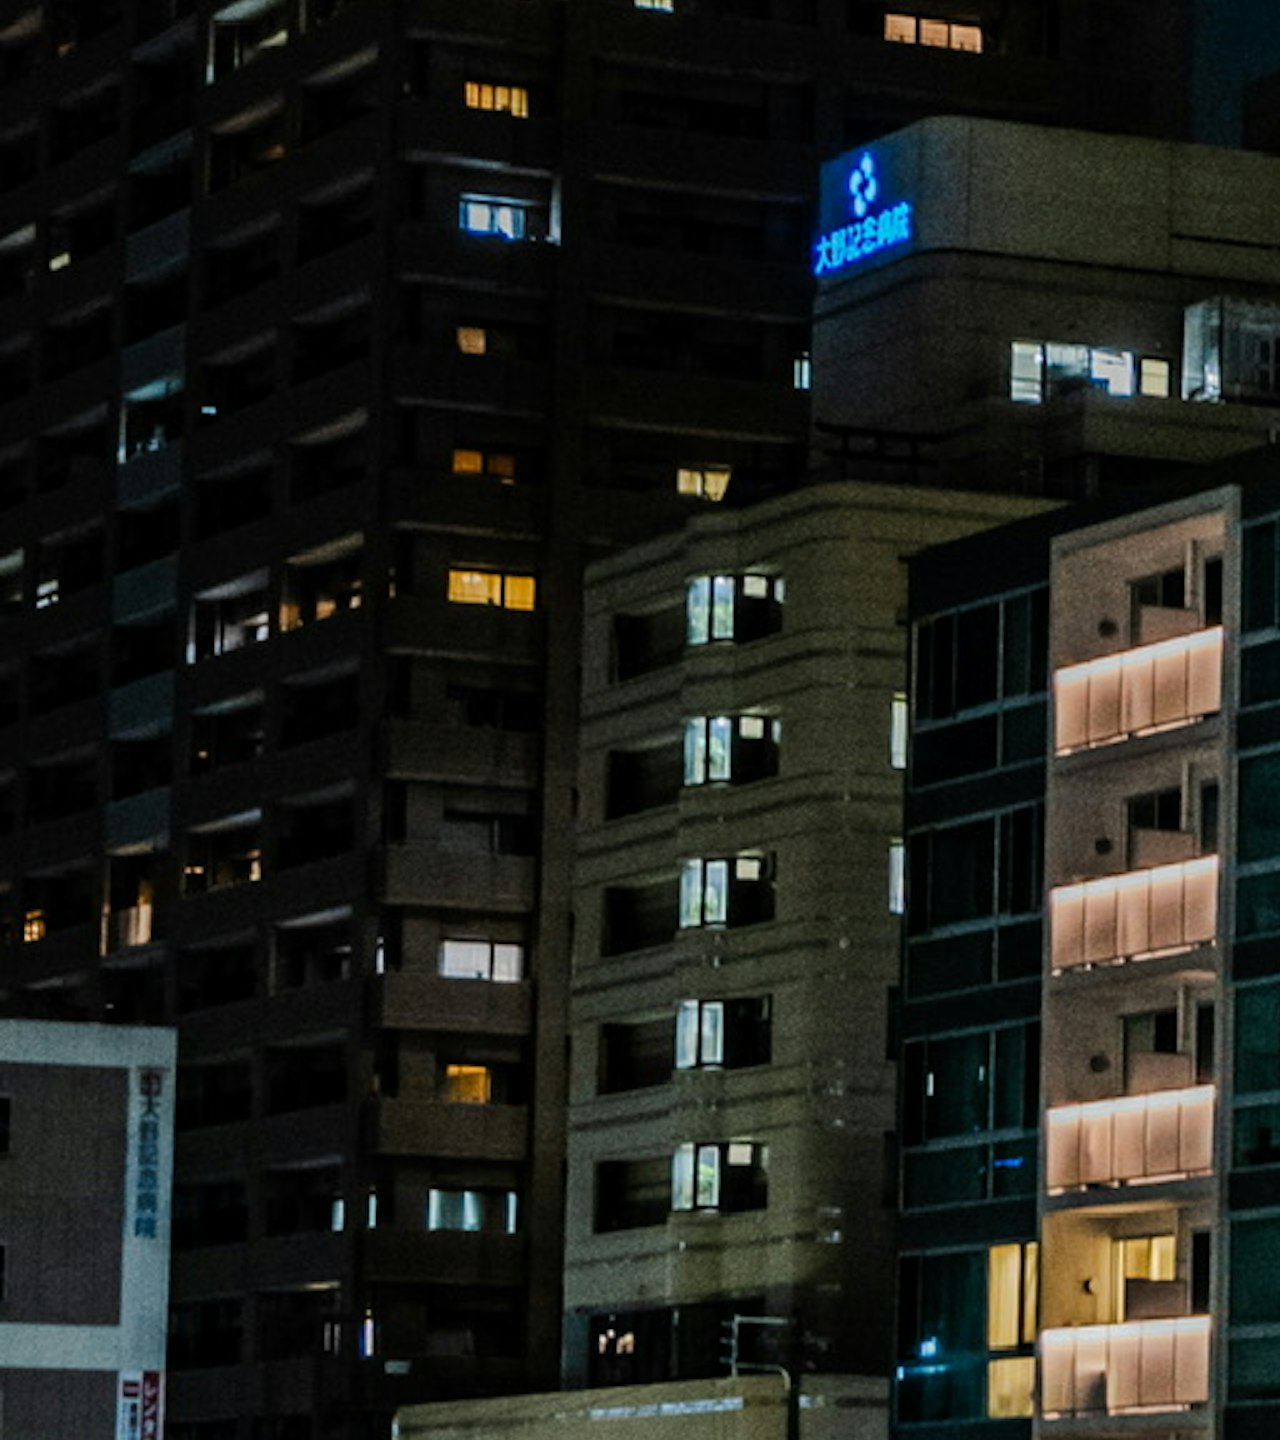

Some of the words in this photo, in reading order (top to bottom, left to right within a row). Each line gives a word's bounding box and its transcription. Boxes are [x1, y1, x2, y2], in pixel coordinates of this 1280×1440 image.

[815, 201, 911, 276] 大野記念病院
